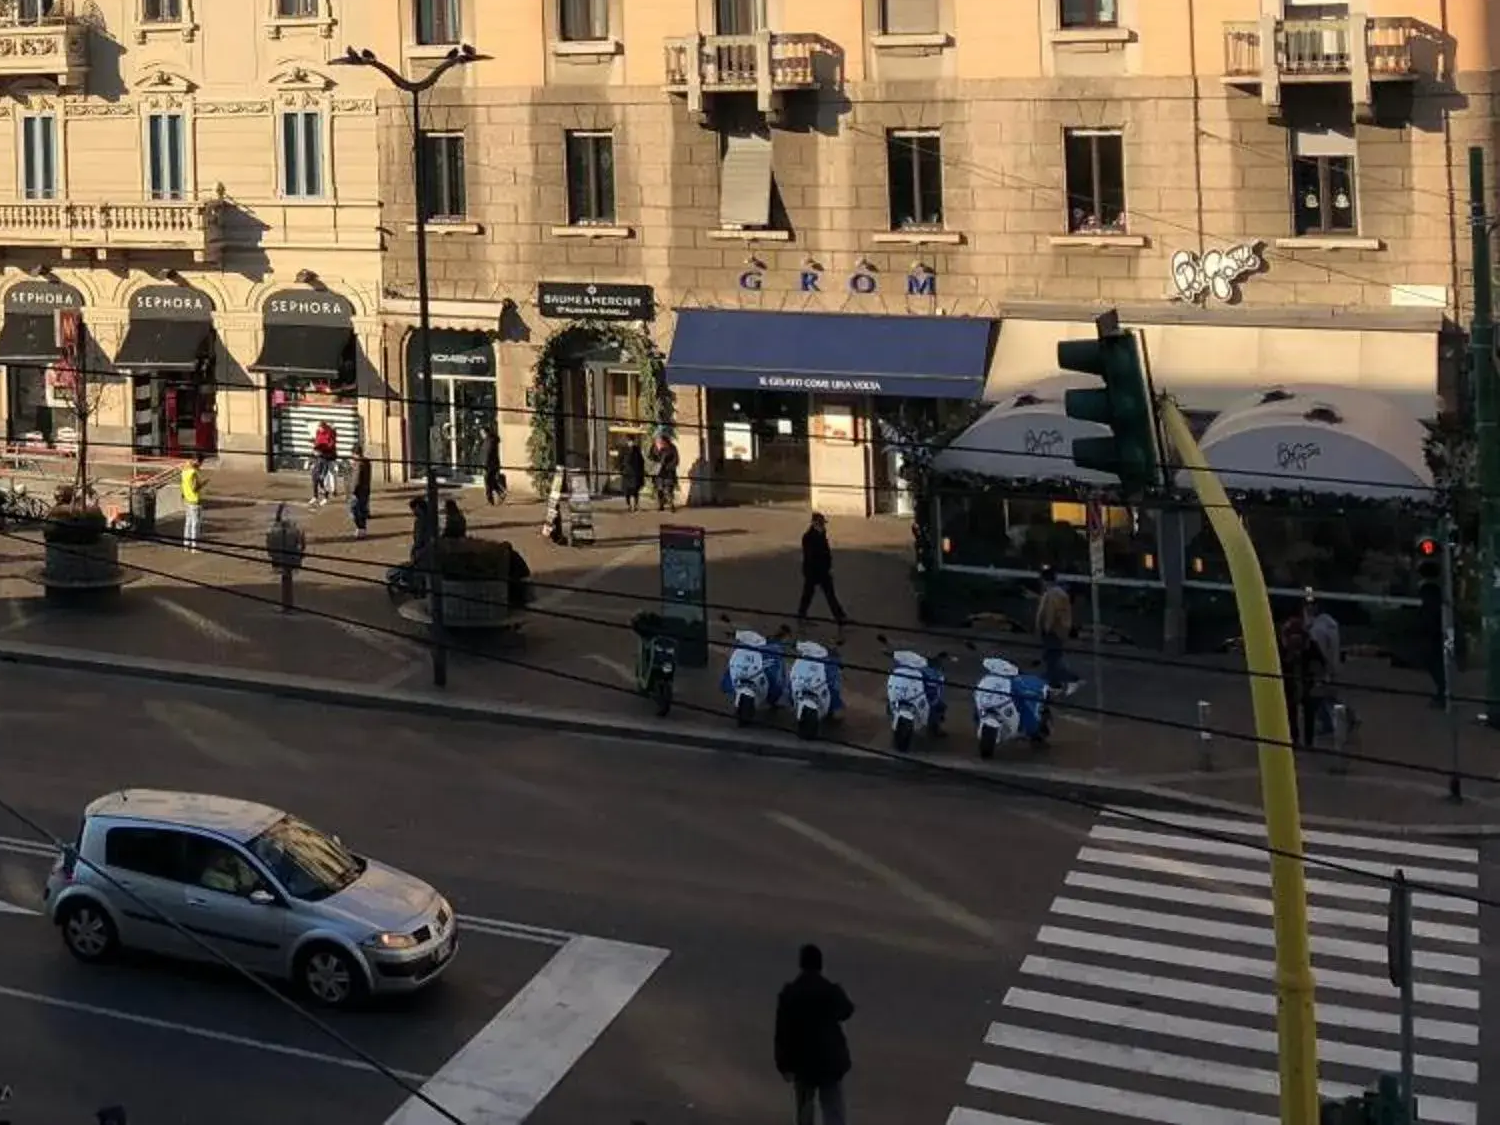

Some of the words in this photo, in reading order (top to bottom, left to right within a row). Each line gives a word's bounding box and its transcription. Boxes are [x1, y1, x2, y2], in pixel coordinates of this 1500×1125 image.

[739, 271, 936, 296] GROM
[11, 291, 73, 305] SEPHORA
[136, 296, 203, 309] SEPHORA
[543, 294, 582, 305] BAUME
[592, 296, 642, 307] MERCIER
[271, 300, 342, 314] SEPHORA
[804, 378, 829, 388] COME
